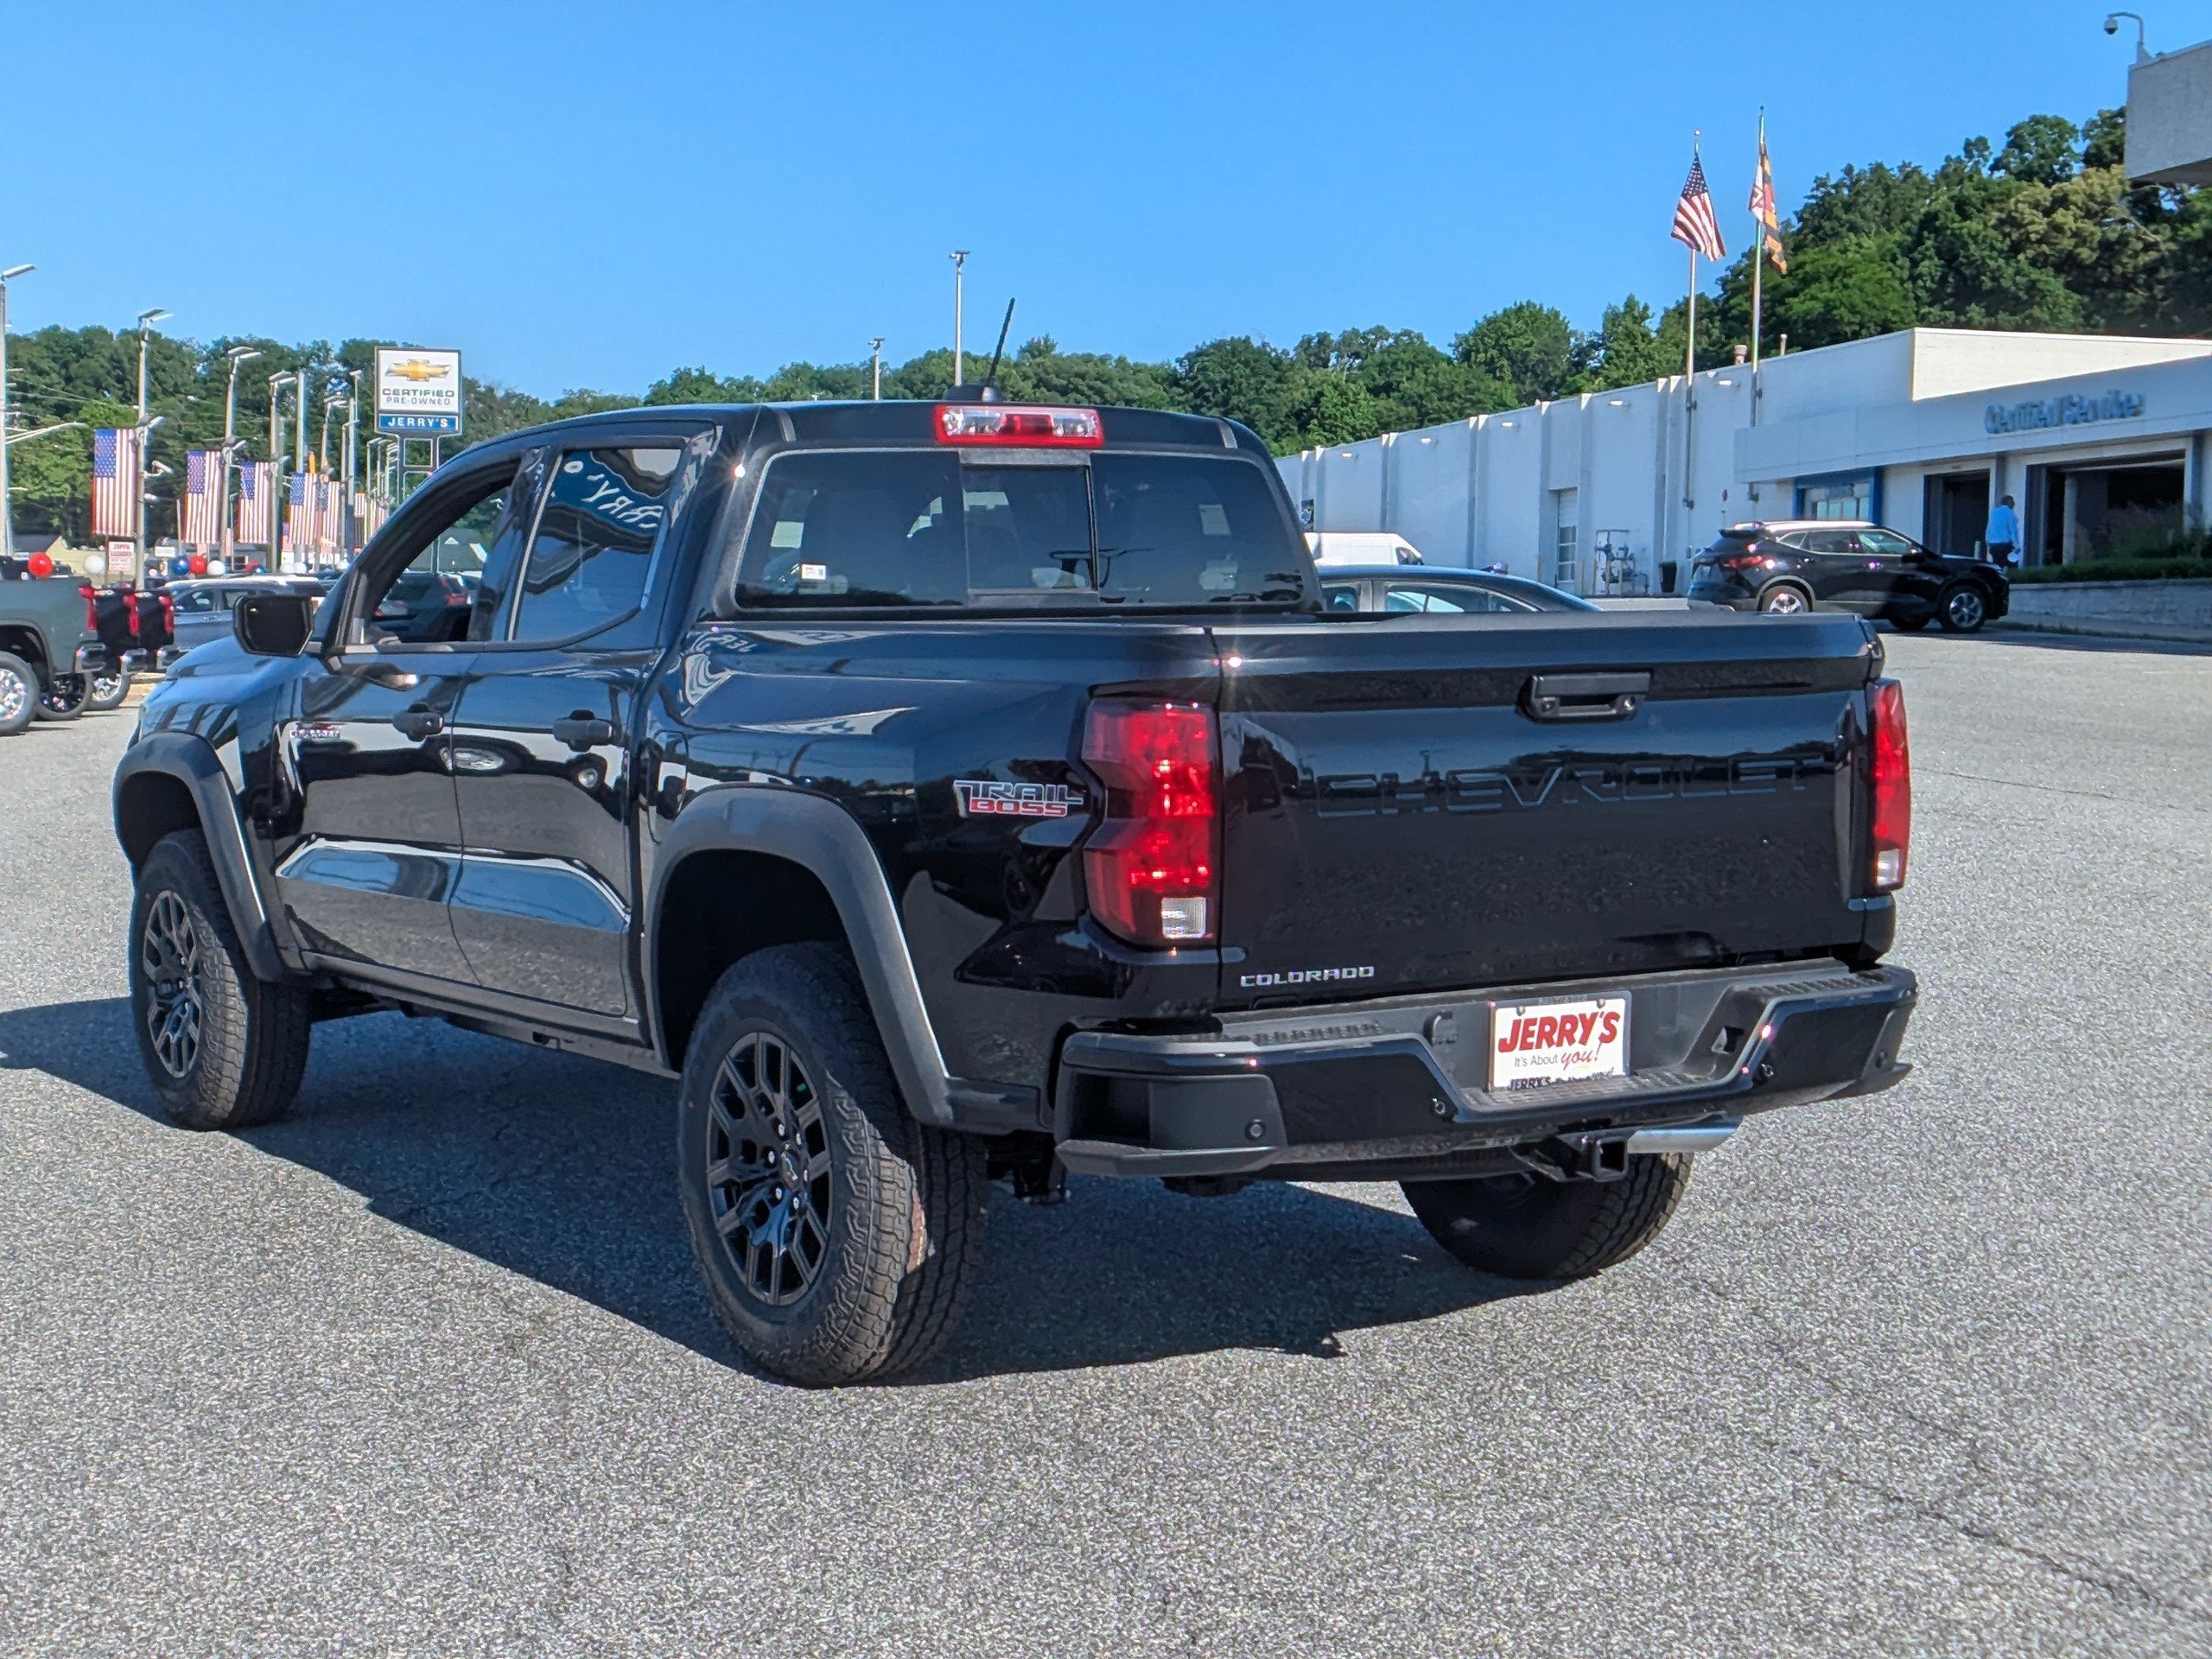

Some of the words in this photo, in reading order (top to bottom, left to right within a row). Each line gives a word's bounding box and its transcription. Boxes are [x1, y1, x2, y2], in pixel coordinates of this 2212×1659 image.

[382, 388, 454, 397] CERTIFIED
[386, 397, 450, 405] PRE-OWNED
[388, 417, 448, 428] JERRY'S
[953, 779, 1084, 805] TRAIL
[1316, 758, 1825, 817] CHEVROLET
[969, 797, 1068, 817] BOSS
[1240, 966, 1375, 988] COLORADO
[1498, 1011, 1621, 1052] JERRY'S
[1515, 1056, 1528, 1067] It's
[1529, 1054, 1559, 1065] About
[1560, 1042, 1602, 1070] you!
